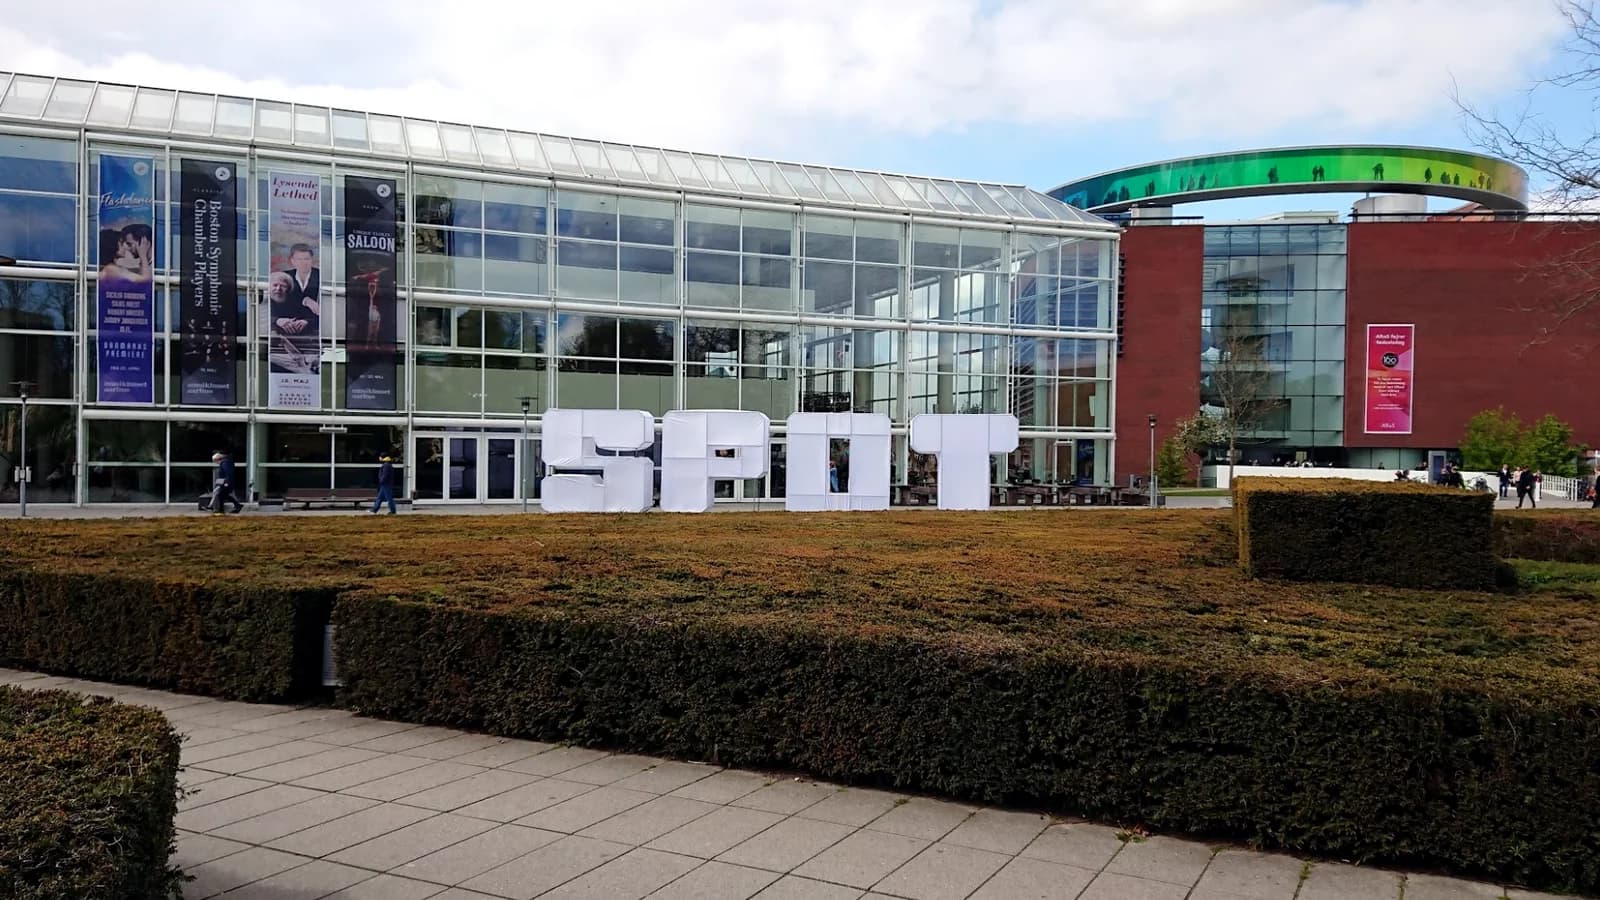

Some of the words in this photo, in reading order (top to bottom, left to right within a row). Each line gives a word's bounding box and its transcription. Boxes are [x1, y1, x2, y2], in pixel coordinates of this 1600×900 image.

[273, 177, 318, 189] Lysende
[273, 188, 318, 201] Lethed
[194, 198, 207, 259] Chamber
[209, 200, 222, 243] Boston
[347, 233, 395, 253] SALOON
[191, 262, 207, 308] Players
[206, 247, 222, 316] Symphonic
[541, 408, 1020, 513] SPOT
